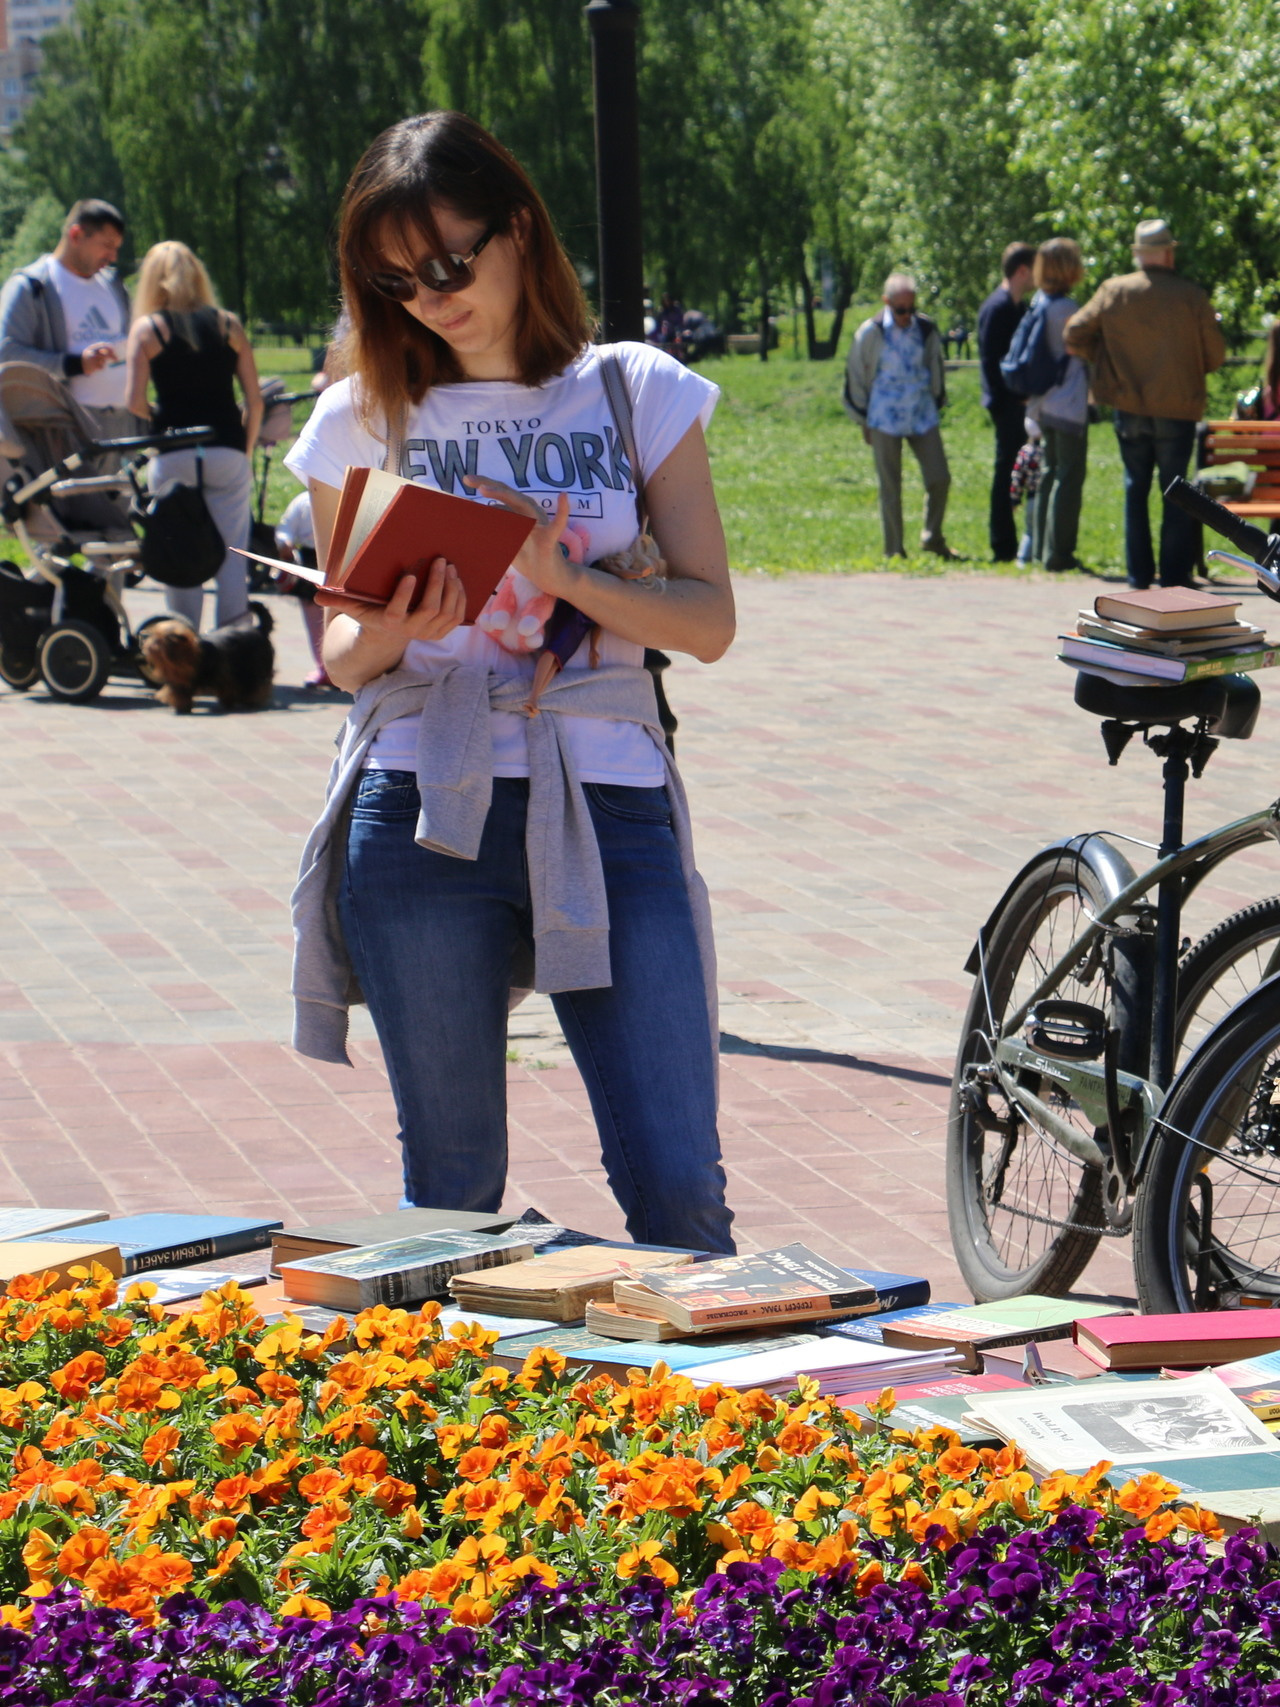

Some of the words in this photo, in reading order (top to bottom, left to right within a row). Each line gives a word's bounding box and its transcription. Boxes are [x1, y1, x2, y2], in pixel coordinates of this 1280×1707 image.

[462, 417, 542, 435] TOKYO
[400, 438, 480, 496] EW
[497, 426, 635, 494] YORK
[137, 1251, 171, 1269] ЗАВЕТ
